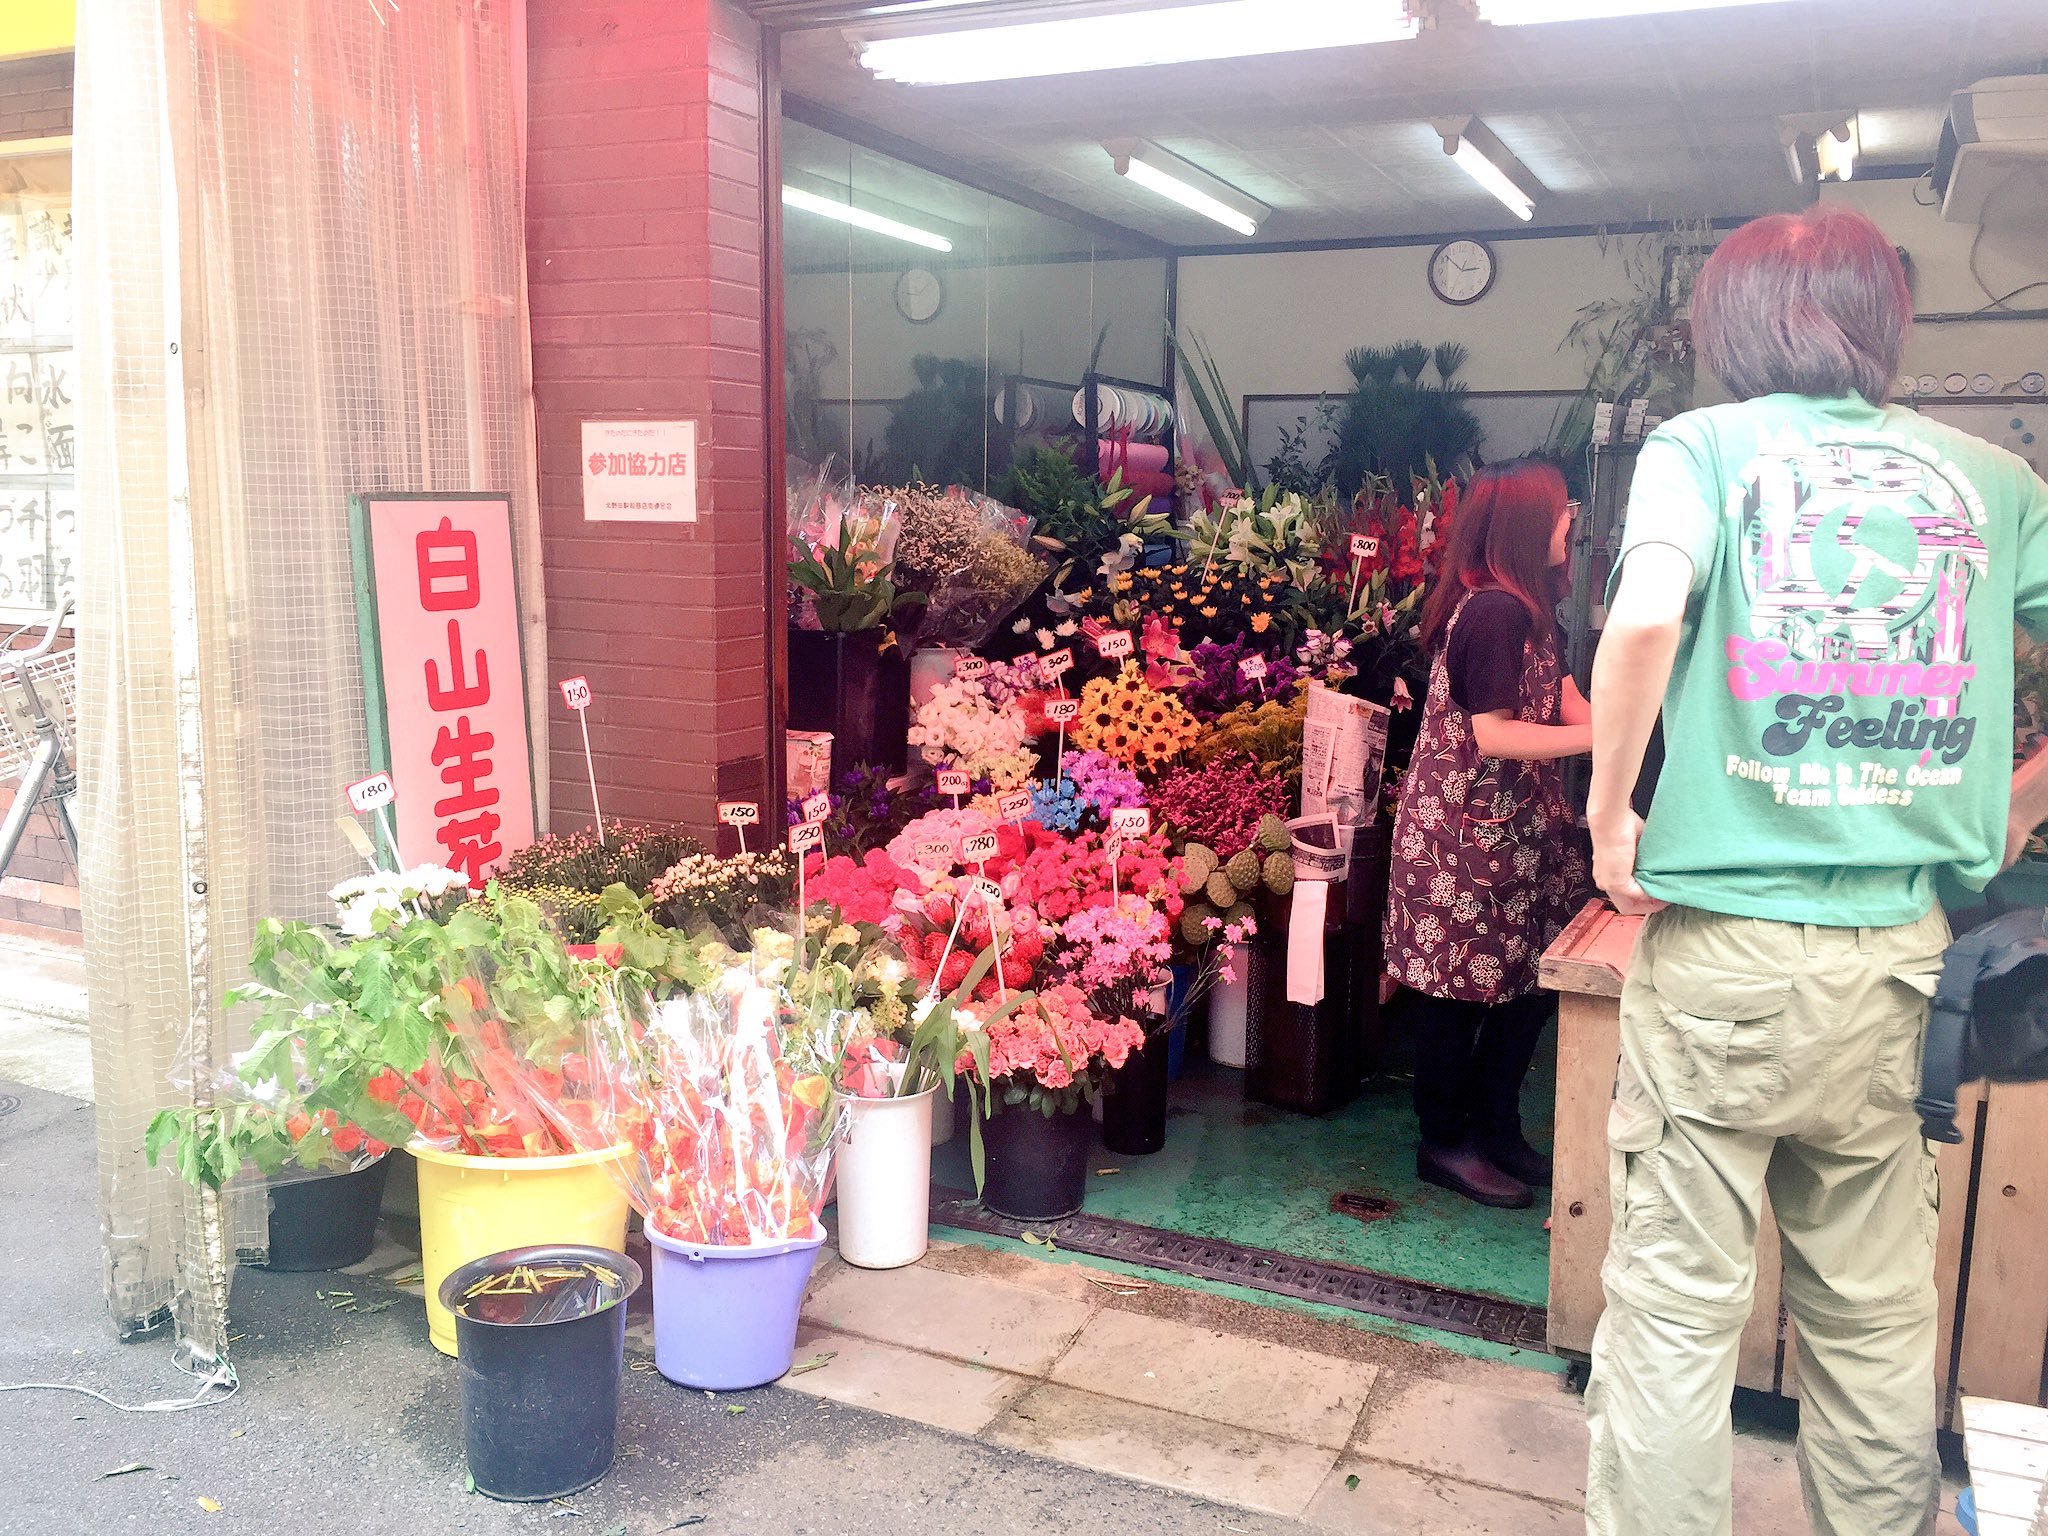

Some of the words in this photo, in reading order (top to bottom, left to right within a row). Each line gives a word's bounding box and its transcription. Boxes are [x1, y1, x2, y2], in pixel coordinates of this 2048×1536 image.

[588, 451, 687, 477] 参加協力店
[1356, 539, 1376, 551] 800
[1107, 638, 1127, 651] 150
[962, 660, 983, 670] 300
[1047, 654, 1069, 668] 300
[1725, 635, 1976, 702] Summer
[567, 686, 588, 702] 150
[416, 516, 502, 890] 白山生花
[1053, 704, 1076, 715] 180
[1761, 694, 1977, 765] Feeling
[1726, 754, 1791, 785] Follow
[1799, 762, 1831, 786] Me
[1860, 761, 1899, 785] The
[1905, 764, 1963, 787] Ocean
[361, 782, 387, 799] 180
[1773, 784, 1832, 807] Team
[730, 806, 755, 818] 150
[808, 802, 827, 820] 150
[1009, 797, 1029, 811] 250
[1121, 816, 1145, 828] 150
[796, 826, 820, 842] 250
[924, 844, 949, 854] 300
[981, 881, 1000, 898] 150
